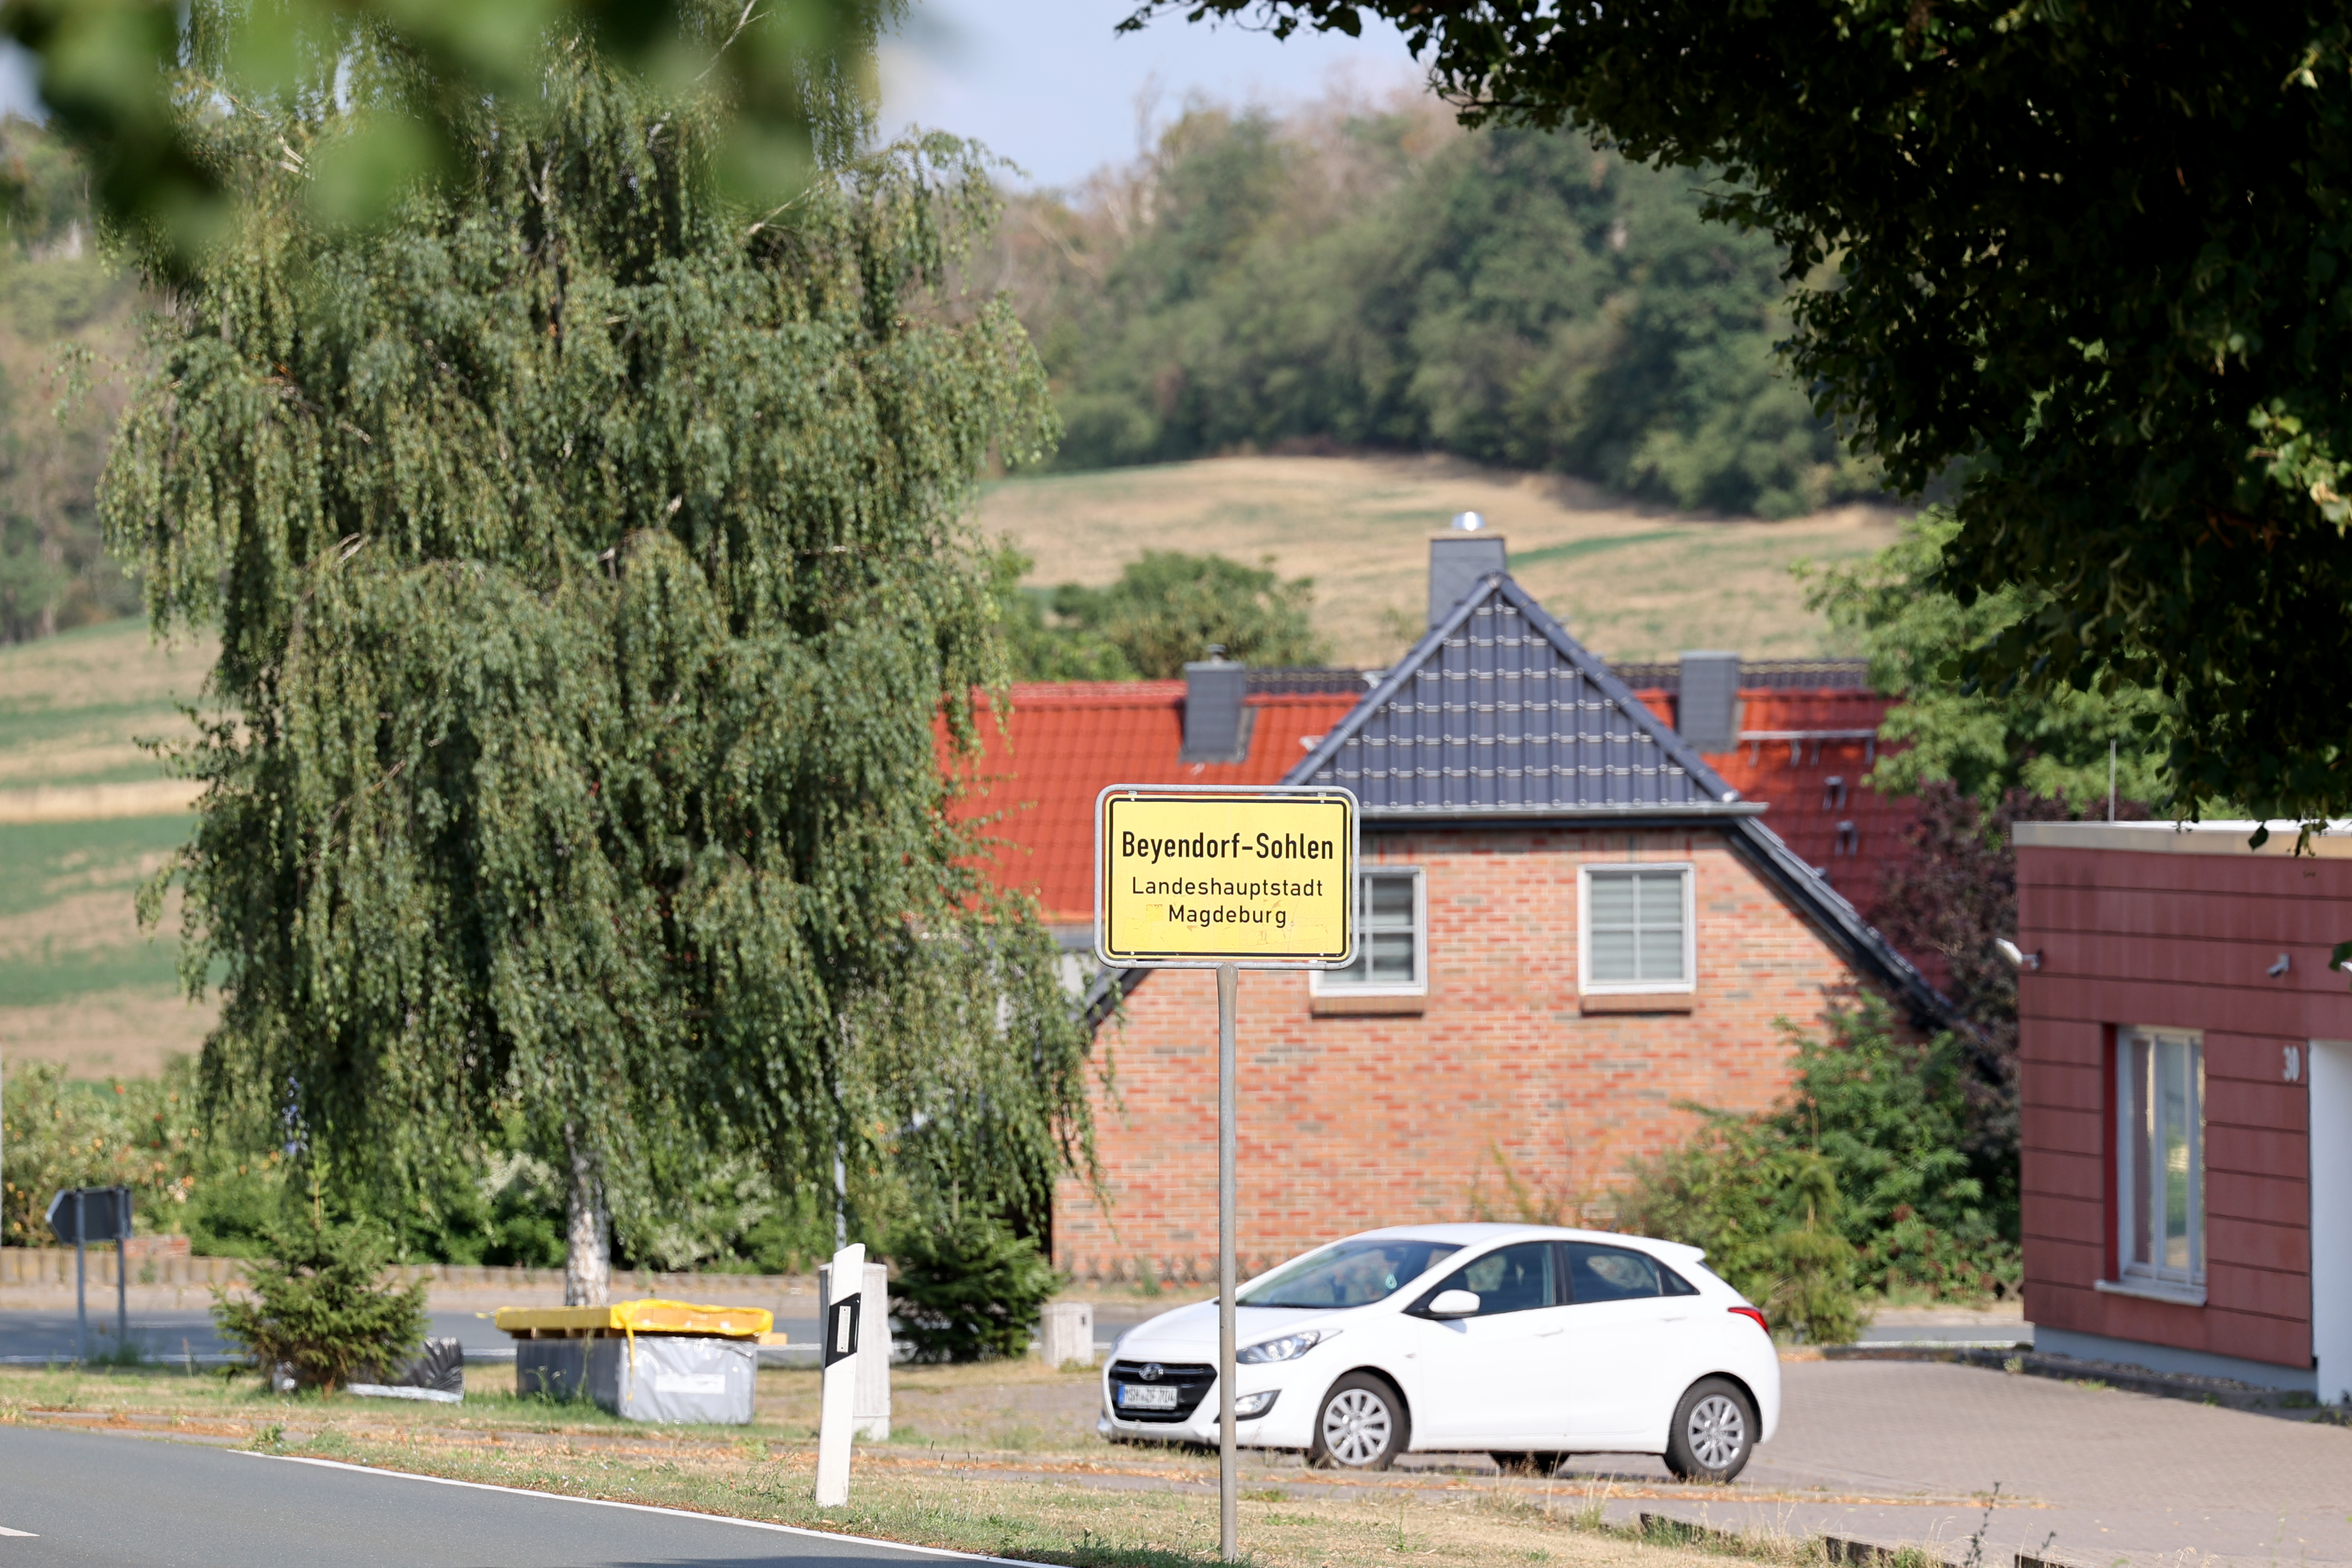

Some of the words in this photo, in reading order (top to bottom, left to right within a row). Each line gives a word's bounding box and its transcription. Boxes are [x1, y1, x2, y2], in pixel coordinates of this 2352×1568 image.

[1122, 831, 1333, 864] Beyendorf-Sohlen
[1133, 877, 1323, 900] Landeshauptstadt
[1169, 904, 1287, 928] Magdeburg
